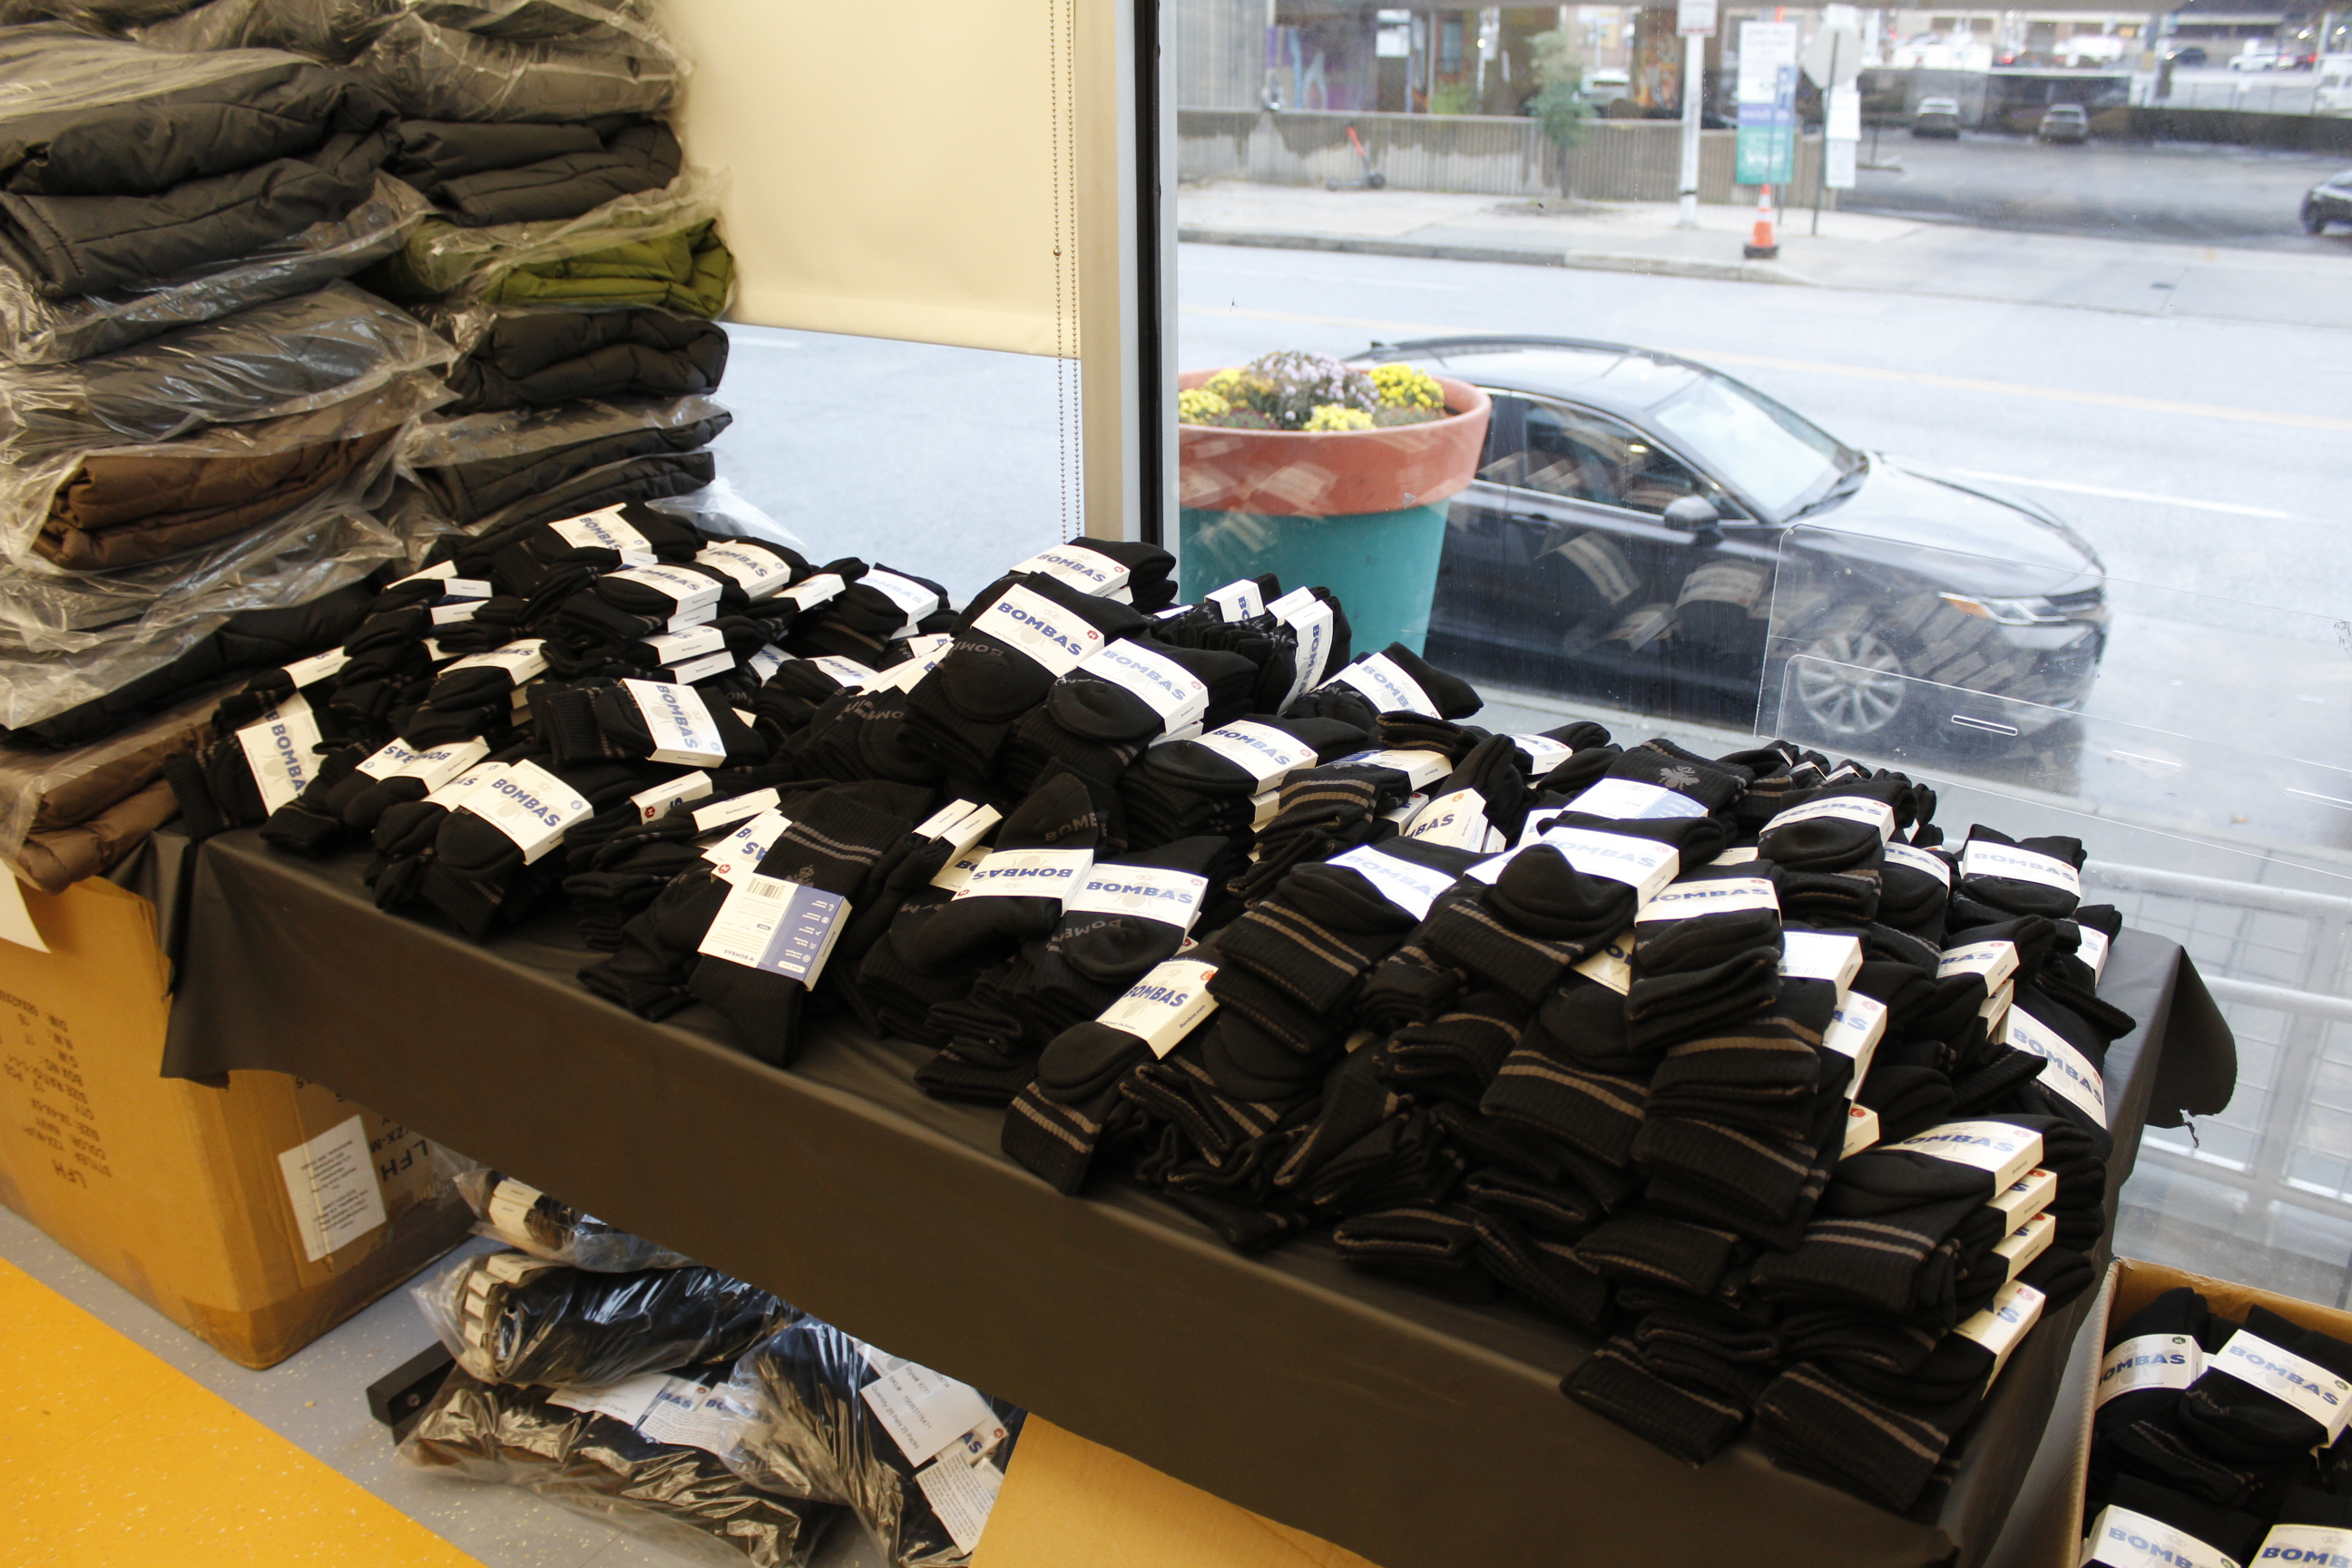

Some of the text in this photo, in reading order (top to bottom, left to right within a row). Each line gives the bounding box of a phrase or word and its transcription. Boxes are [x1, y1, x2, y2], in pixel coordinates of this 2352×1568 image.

[1036, 554, 1107, 583] BOMBAS
[997, 602, 1083, 656] BOMBAS
[1102, 650, 1186, 701] BOMBAS
[1298, 623, 1320, 698] BOMBA
[656, 684, 700, 750] BOMBAS
[270, 724, 308, 797] BOMBA
[1212, 730, 1291, 766] BOMBAS
[490, 778, 562, 828] BOMBAS
[972, 867, 1074, 881] BOMBAS
[1345, 856, 1440, 900] BOMBA
[1974, 853, 2076, 882] BOMBAS
[1086, 881, 1193, 905] BOMBAS
[724, 949, 749, 961] BOMBAS
[1179, 1004, 1207, 1029] Bombas.com
[2013, 1026, 2103, 1107] BOMBAS
[379, 1139, 428, 1182] LFH
[1896, 1133, 2015, 1152] OMBAS
[2228, 1345, 2339, 1406] BOMBAS
[906, 1432, 919, 1450] Packs
[2108, 1527, 2205, 1568] BOMB
